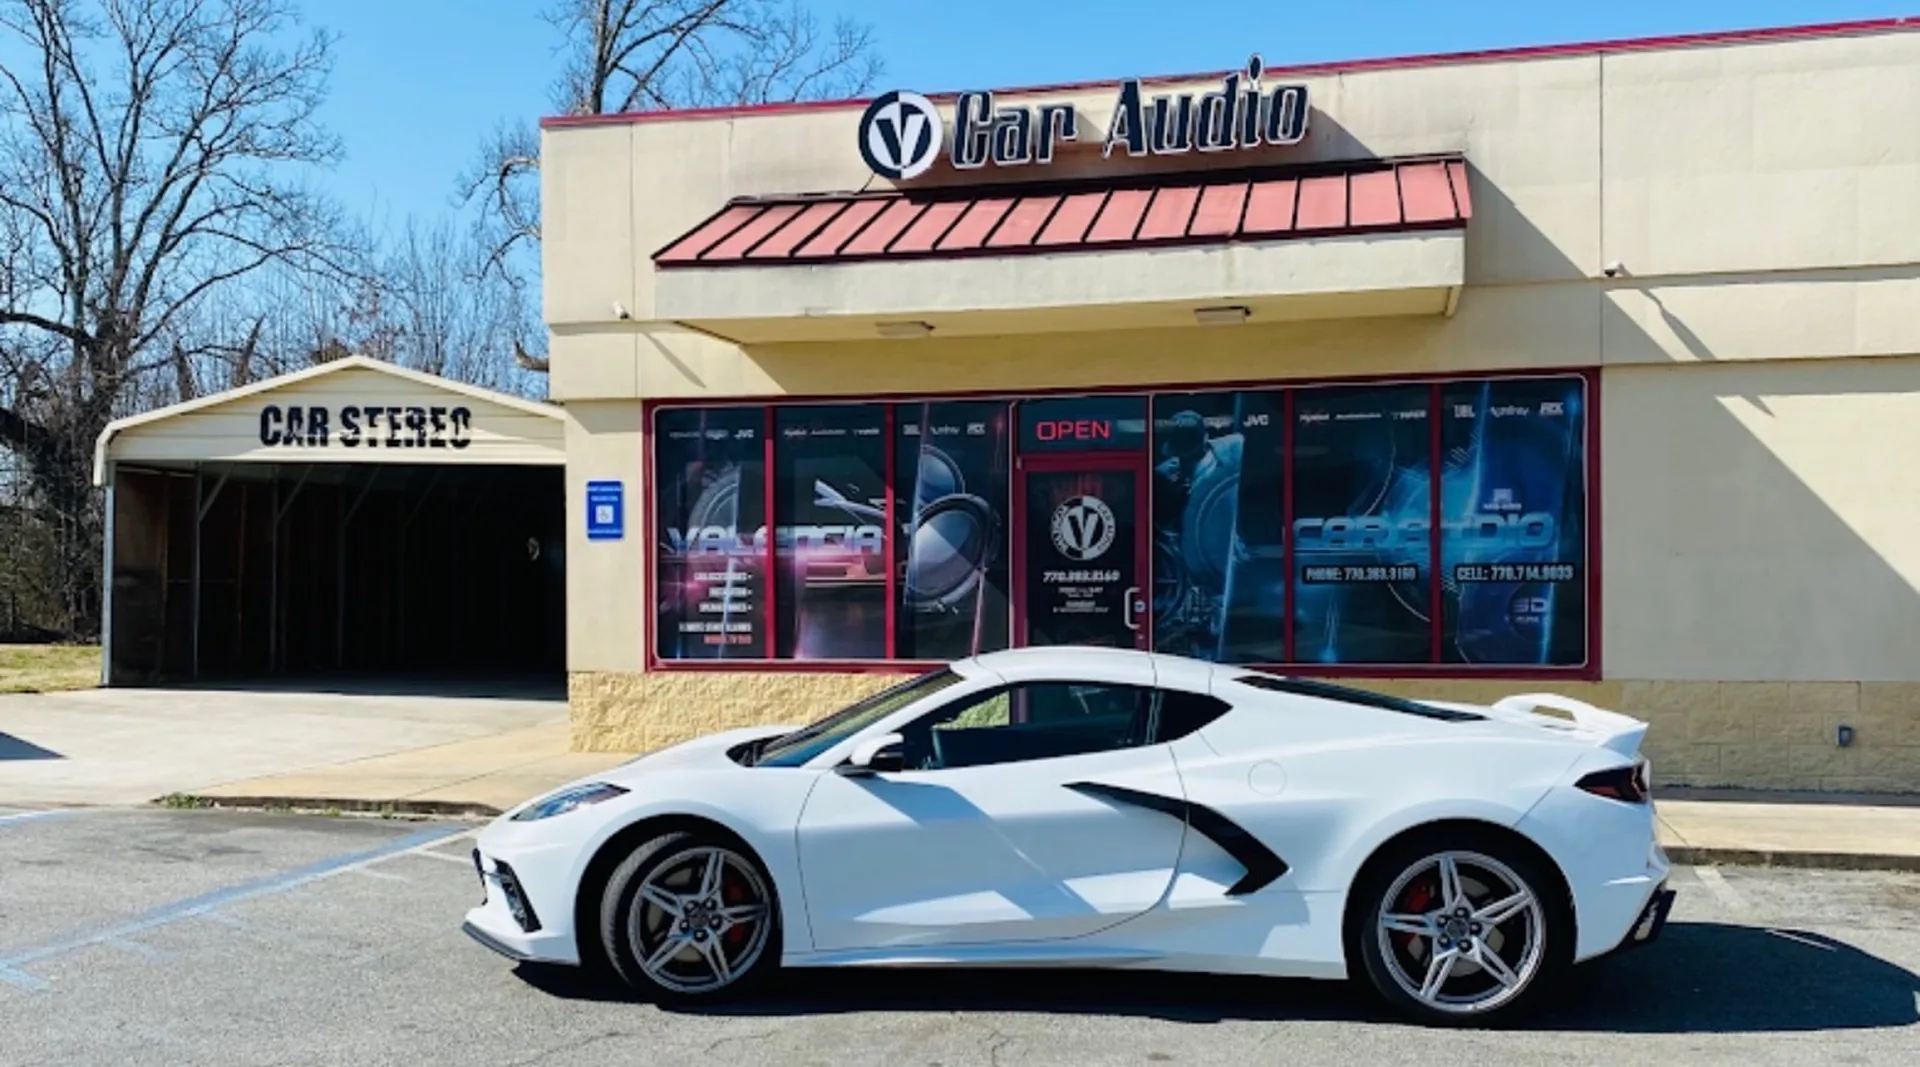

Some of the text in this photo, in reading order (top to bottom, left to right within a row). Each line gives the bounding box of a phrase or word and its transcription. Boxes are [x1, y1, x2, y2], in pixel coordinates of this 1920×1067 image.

[951, 90, 1078, 170] Car
[1103, 53, 1310, 159] Audio
[259, 405, 473, 450] CAR STEREO
[1243, 414, 1269, 427] JVC
[1035, 419, 1111, 441] OPEN
[1306, 567, 1343, 581] PHONE:
[1456, 567, 1489, 581] CELL:
